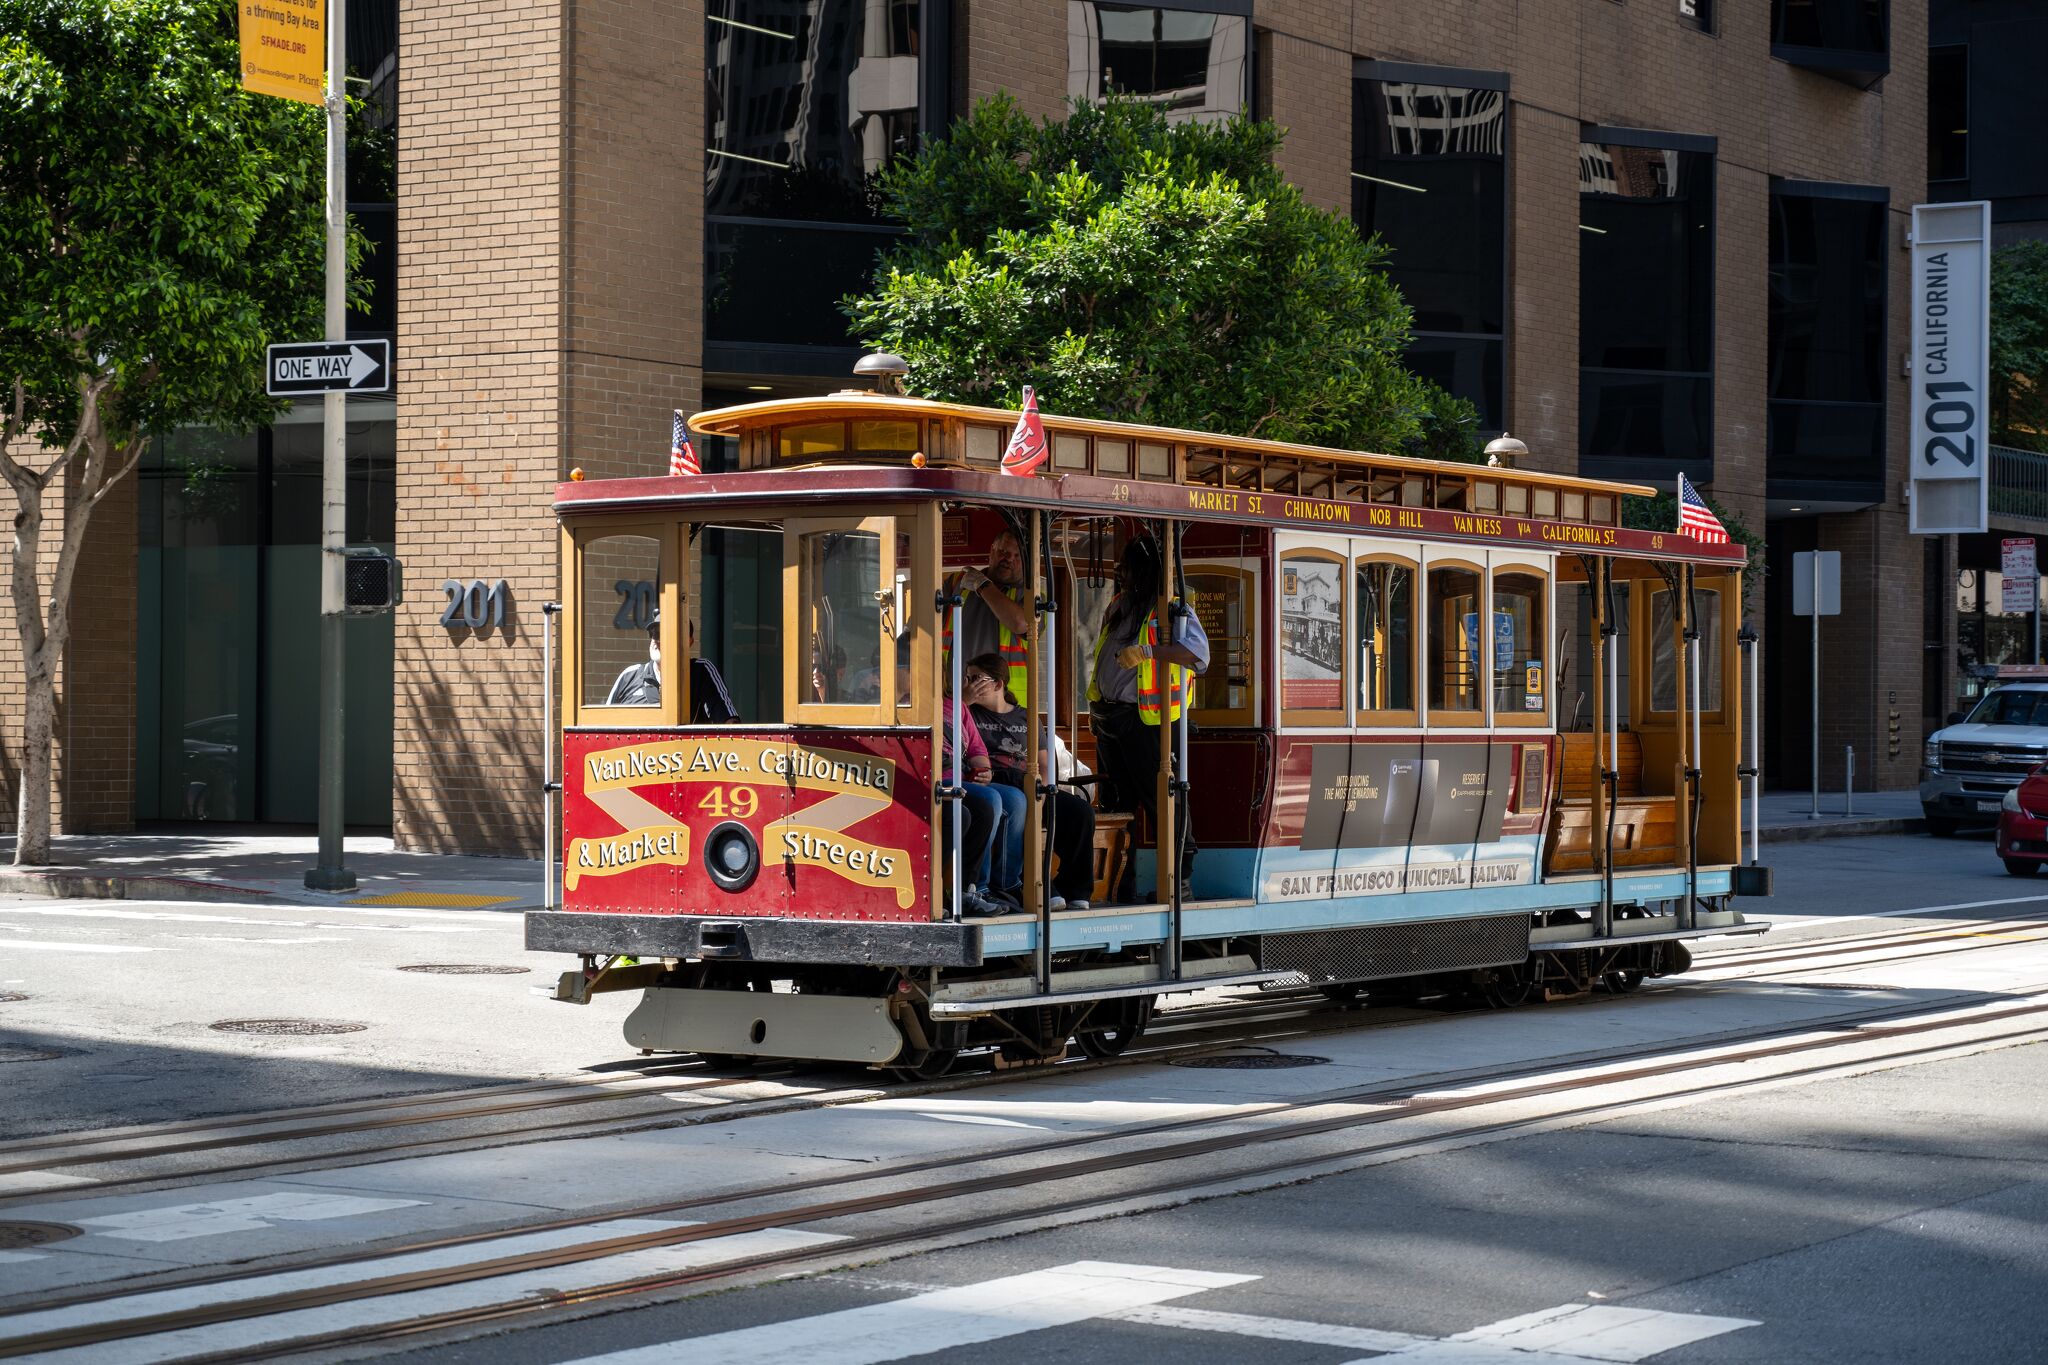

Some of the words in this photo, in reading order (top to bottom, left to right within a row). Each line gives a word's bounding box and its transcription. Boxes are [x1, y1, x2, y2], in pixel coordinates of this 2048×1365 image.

[246, 6, 252, 16] a
[254, 4, 285, 26] thriving
[286, 10, 301, 29] Bay
[302, 14, 319, 30] Area
[261, 35, 306, 54] SFMADE.ORG
[1925, 251, 1949, 375] CALIFORNIA
[278, 359, 312, 379] ONE
[317, 356, 353, 378] WAY
[1924, 381, 1975, 468] 201
[1112, 483, 1129, 502] 49
[1188, 490, 1239, 512] MARKET
[1284, 501, 1350, 522] CHINATOWN
[1369, 508, 1391, 526] NOB
[1399, 511, 1424, 528] HILL
[1453, 515, 1473, 533] VAN
[1476, 517, 1501, 536] NESS
[1542, 524, 1601, 545] CALIFORNIA
[1651, 535, 1663, 550] 49
[439, 579, 507, 629] 201
[1200, 592, 1212, 601] ONE
[1213, 592, 1226, 601] WAY
[589, 756, 626, 783] Van
[627, 750, 683, 778] Ness
[758, 748, 890, 791] California
[1462, 773, 1481, 785] RESERVE
[698, 786, 759, 818] 49
[1324, 788, 1334, 800] THE
[579, 840, 594, 868] &
[598, 831, 678, 869] Market
[782, 831, 896, 877] Streets
[1280, 876, 1311, 896] SAN
[1316, 870, 1395, 893] FRANCISCO
